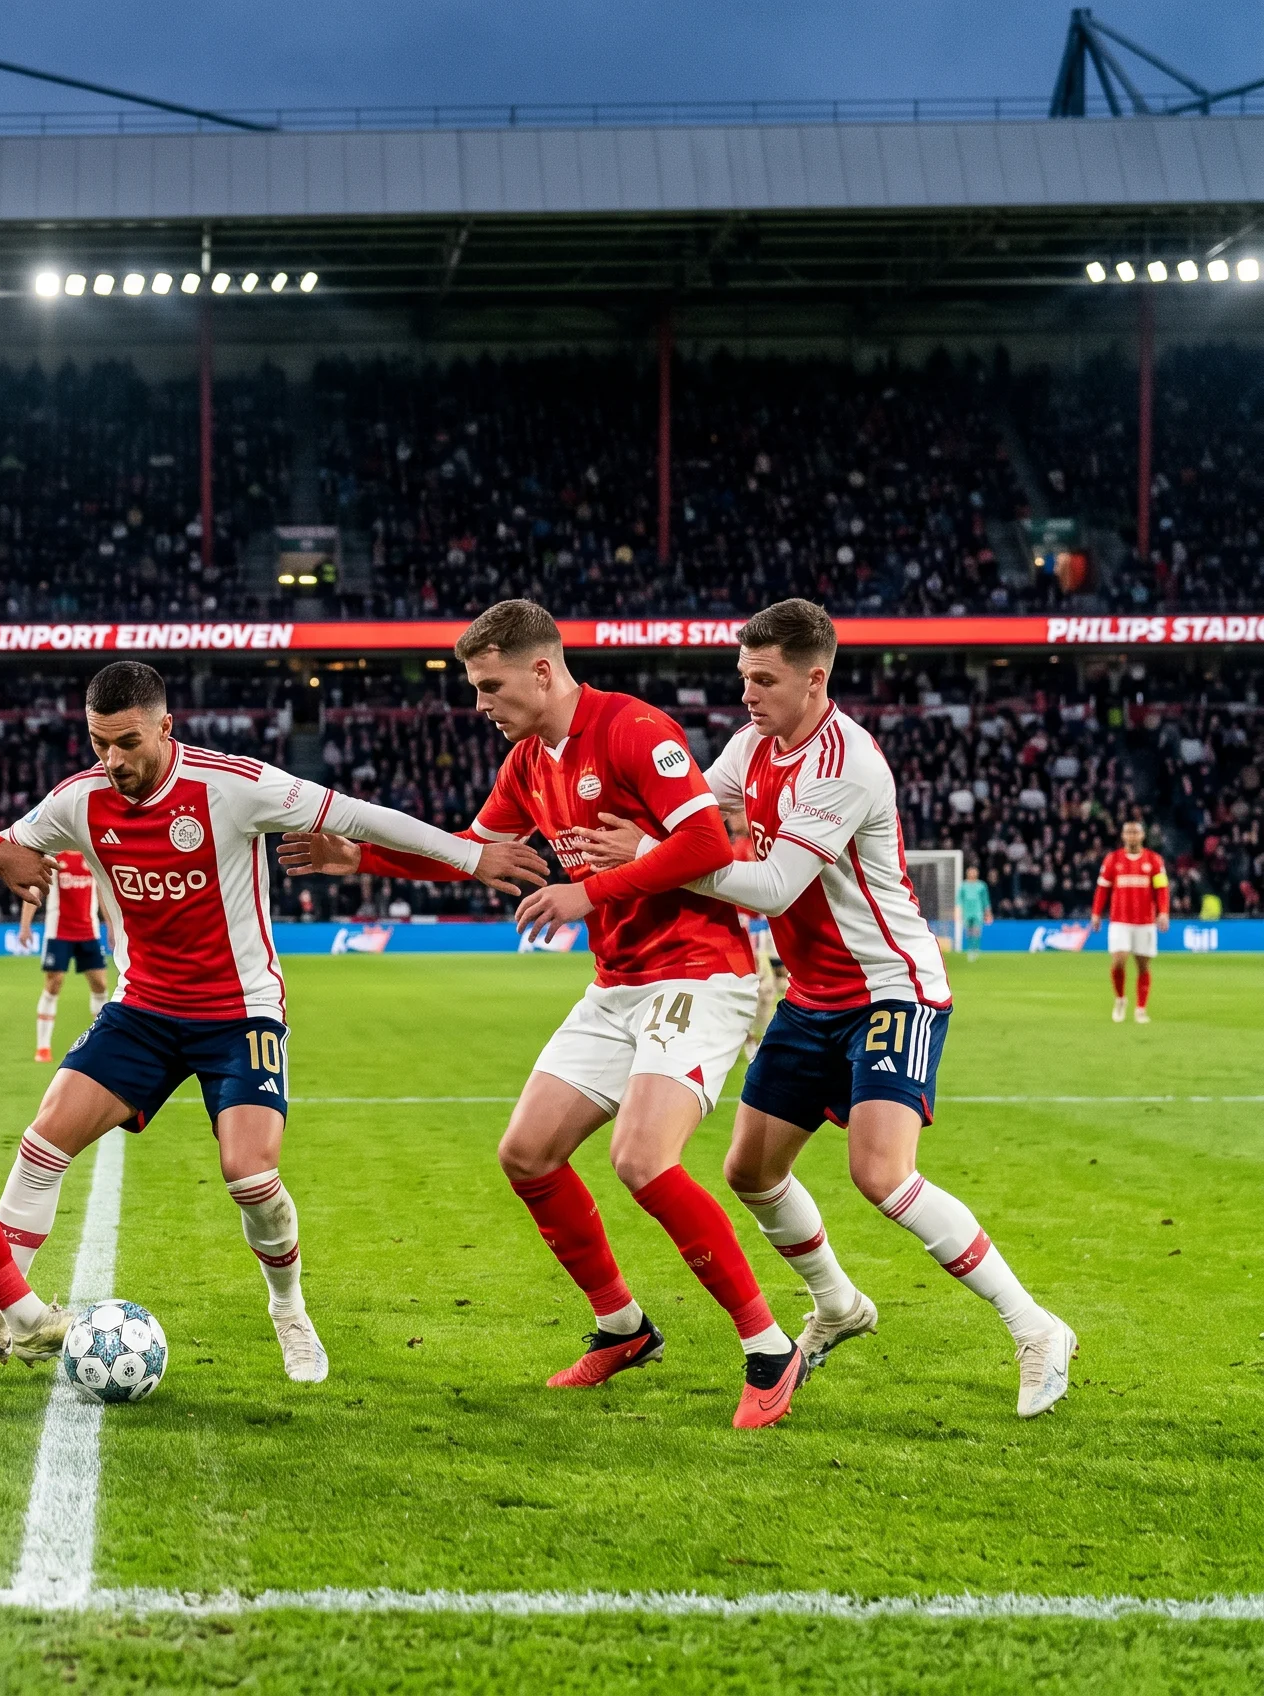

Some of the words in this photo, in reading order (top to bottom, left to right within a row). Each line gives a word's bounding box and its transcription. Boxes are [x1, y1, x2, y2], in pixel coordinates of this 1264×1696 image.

[115, 624, 294, 648] EINDHOVEN
[595, 621, 684, 645] PHILIPS
[1047, 617, 1166, 643] PHILIPS
[644, 992, 694, 1034] 14
[865, 1010, 907, 1053] 21
[245, 1030, 281, 1074] 10
